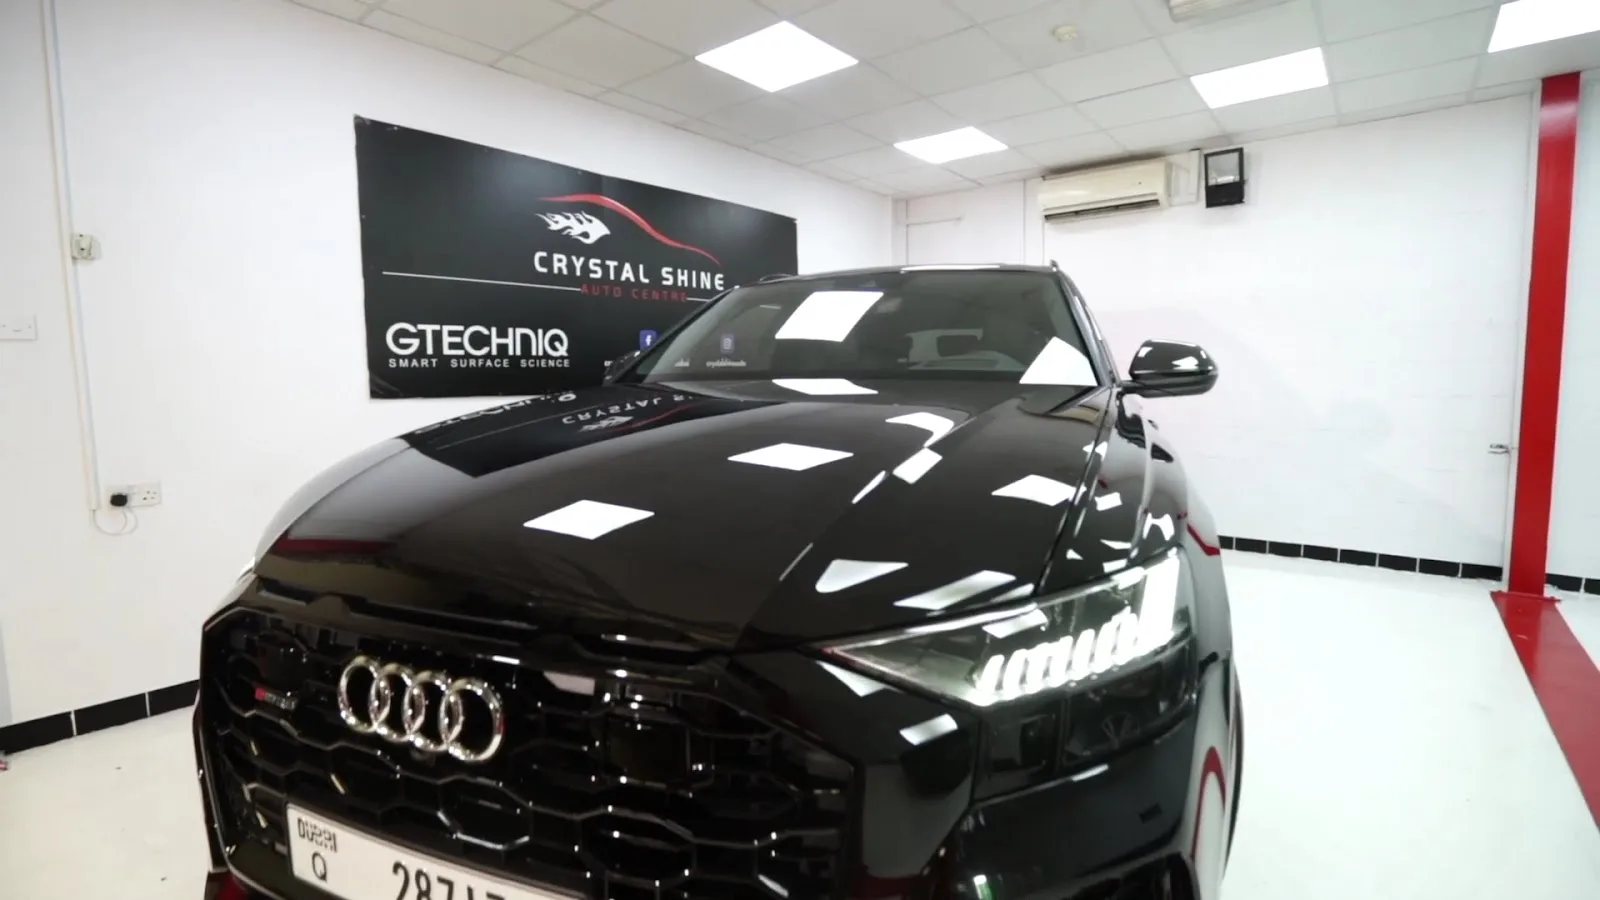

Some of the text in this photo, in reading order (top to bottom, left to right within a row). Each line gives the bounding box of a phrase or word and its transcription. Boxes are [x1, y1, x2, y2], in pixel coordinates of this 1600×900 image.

[533, 251, 725, 291] CRYSTAL SHINE
[580, 283, 688, 302] AUTO CENTRE
[385, 322, 569, 357] GTECHNIQ
[388, 358, 570, 368] SMART SURFACE SCIENCE
[311, 851, 328, 883] Q
[392, 861, 506, 900] 287
